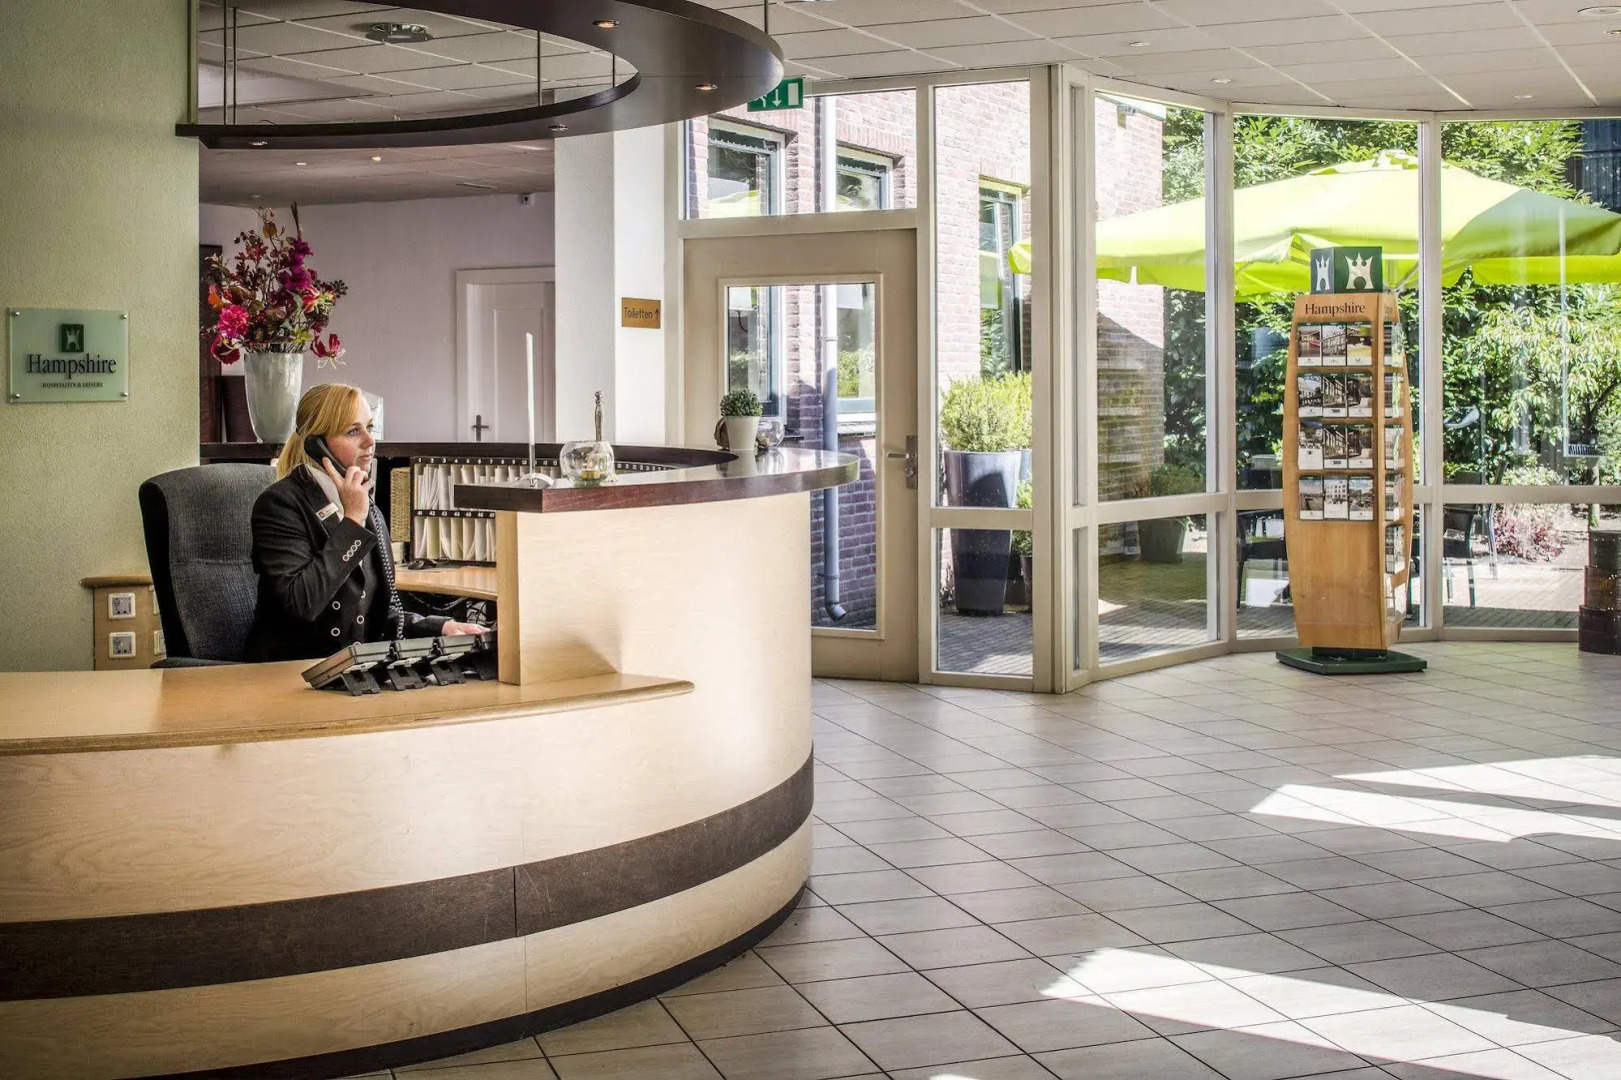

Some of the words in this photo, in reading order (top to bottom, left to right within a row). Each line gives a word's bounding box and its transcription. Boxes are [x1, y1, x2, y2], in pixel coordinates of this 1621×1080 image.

[624, 307, 653, 319] Toiletten
[1305, 302, 1366, 316] Hampshire
[27, 353, 117, 379] Hampshire
